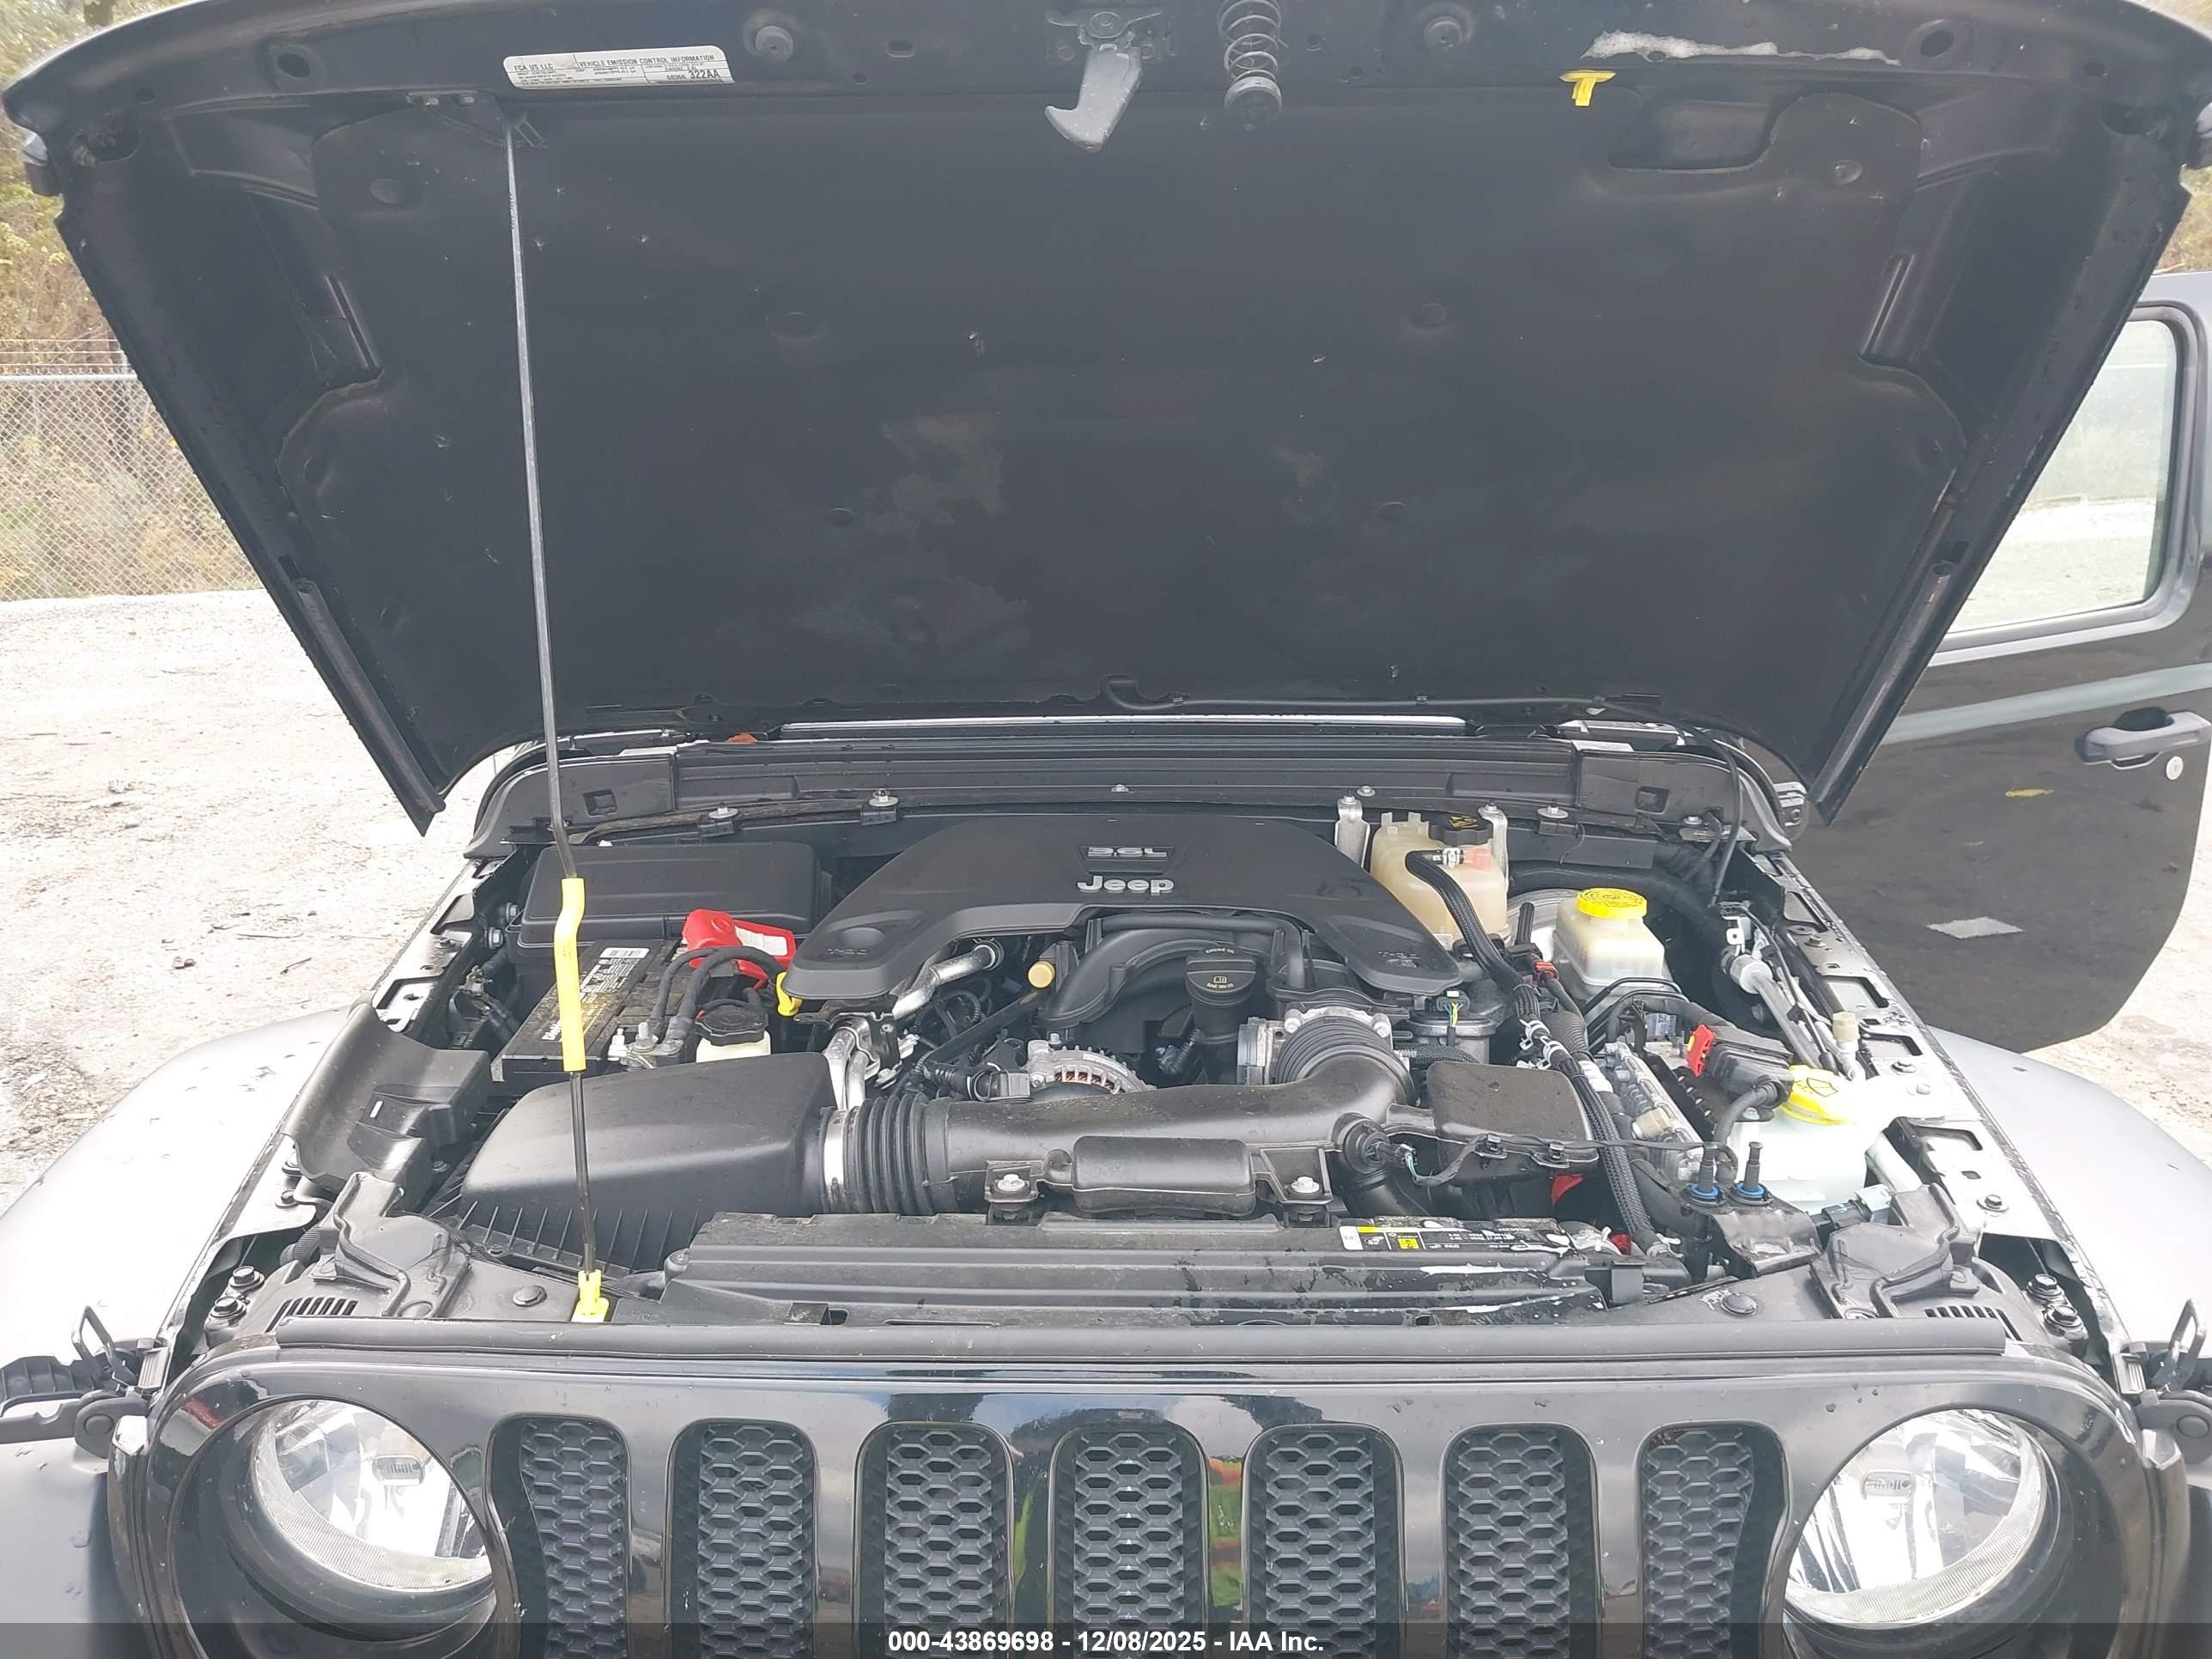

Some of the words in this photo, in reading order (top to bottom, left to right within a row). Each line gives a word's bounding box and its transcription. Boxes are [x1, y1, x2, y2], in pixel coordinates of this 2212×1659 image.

[607, 58, 638, 66] EMISSION
[670, 54, 714, 63] INFORMATION
[688, 70, 721, 79] 322AA
[1077, 875, 1175, 896] Jeep
